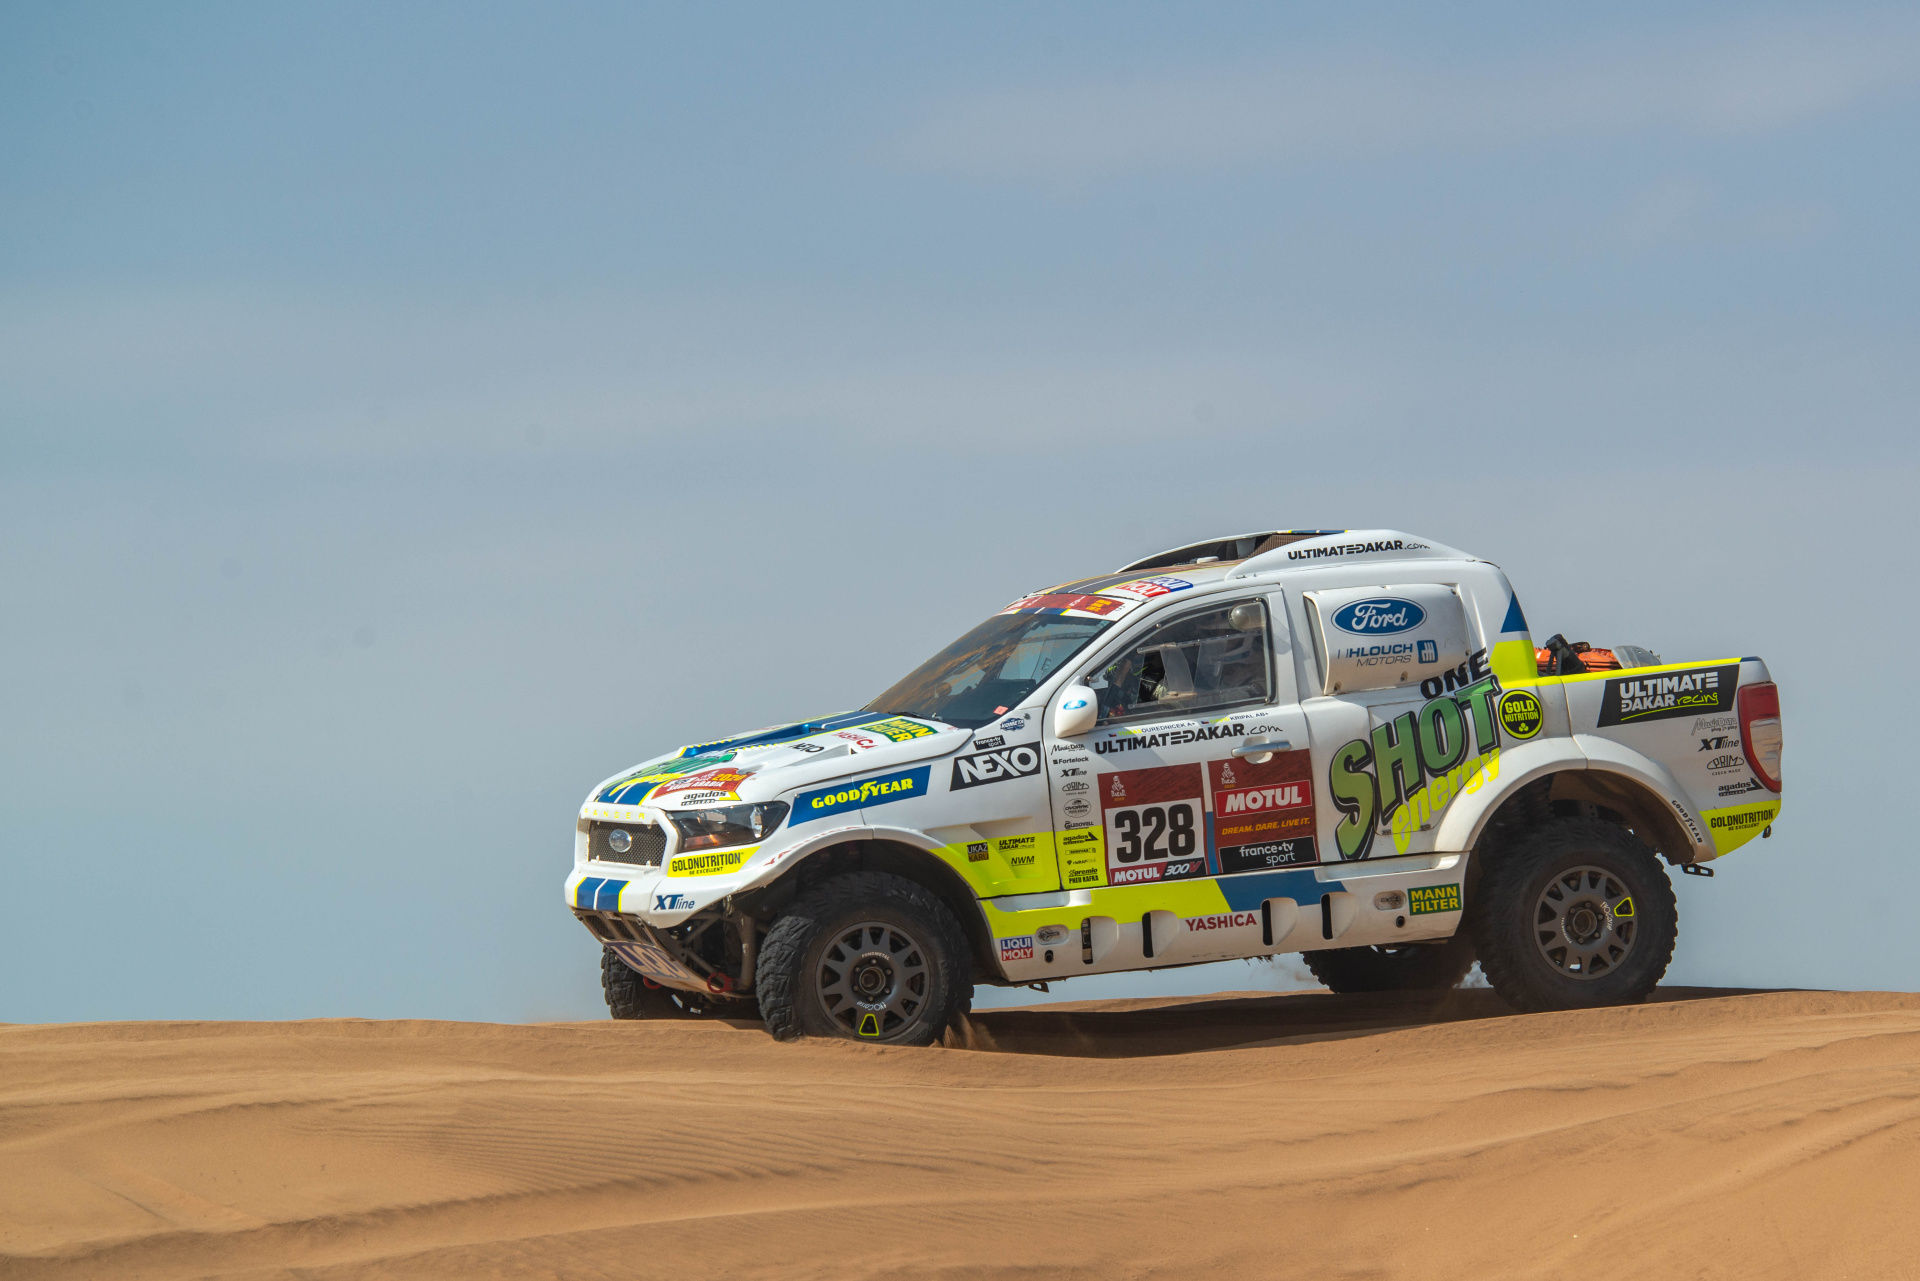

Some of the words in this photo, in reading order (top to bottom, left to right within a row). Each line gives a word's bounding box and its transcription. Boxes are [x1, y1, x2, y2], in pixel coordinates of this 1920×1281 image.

[1352, 602, 1408, 630] Ford
[1348, 643, 1413, 658] HLOUCH
[1356, 655, 1412, 668] MOTORS
[1420, 648, 1492, 699] ONE
[1619, 671, 1719, 699] ULTIMATE
[1504, 700, 1535, 714] GOLD
[1621, 694, 1675, 713] DAKAR
[1676, 690, 1719, 706] racing
[1504, 710, 1539, 723] NUTRITION
[1697, 736, 1740, 752] XTline
[957, 747, 1038, 784] NEXO
[1059, 756, 1089, 765] Fortelock
[1329, 675, 1503, 859] SHOT
[1710, 755, 1741, 769] PRIM
[683, 790, 726, 800] agados
[812, 778, 914, 809] GOODYEAR
[1718, 781, 1751, 793] agados
[1225, 786, 1302, 813] MOTUL
[1392, 748, 1500, 855] energy
[1222, 825, 1254, 835] DREAM.
[1255, 821, 1280, 832] DARE.
[1281, 818, 1299, 828] LIVE
[1300, 817, 1311, 825] IT.
[1671, 800, 1703, 843] GOODYEAR
[1710, 809, 1774, 829] GOLDNUTRITION
[999, 837, 1035, 846] ULTIMATE
[1115, 804, 1195, 863] 328
[672, 851, 741, 873] GOLDNUTRITION
[1011, 856, 1035, 865] NWM
[1266, 852, 1296, 867] sport
[696, 867, 723, 875] EXCELLENT
[1074, 868, 1098, 876] premio
[1114, 867, 1160, 883] MOTUL
[1164, 861, 1202, 876] 300V
[1410, 886, 1458, 901] MANN
[653, 893, 695, 911] XTline
[1412, 898, 1459, 912] FILTER
[1185, 912, 1258, 932] YASHICA
[1002, 937, 1031, 949] LIQUI
[1003, 948, 1032, 960] MOLY
